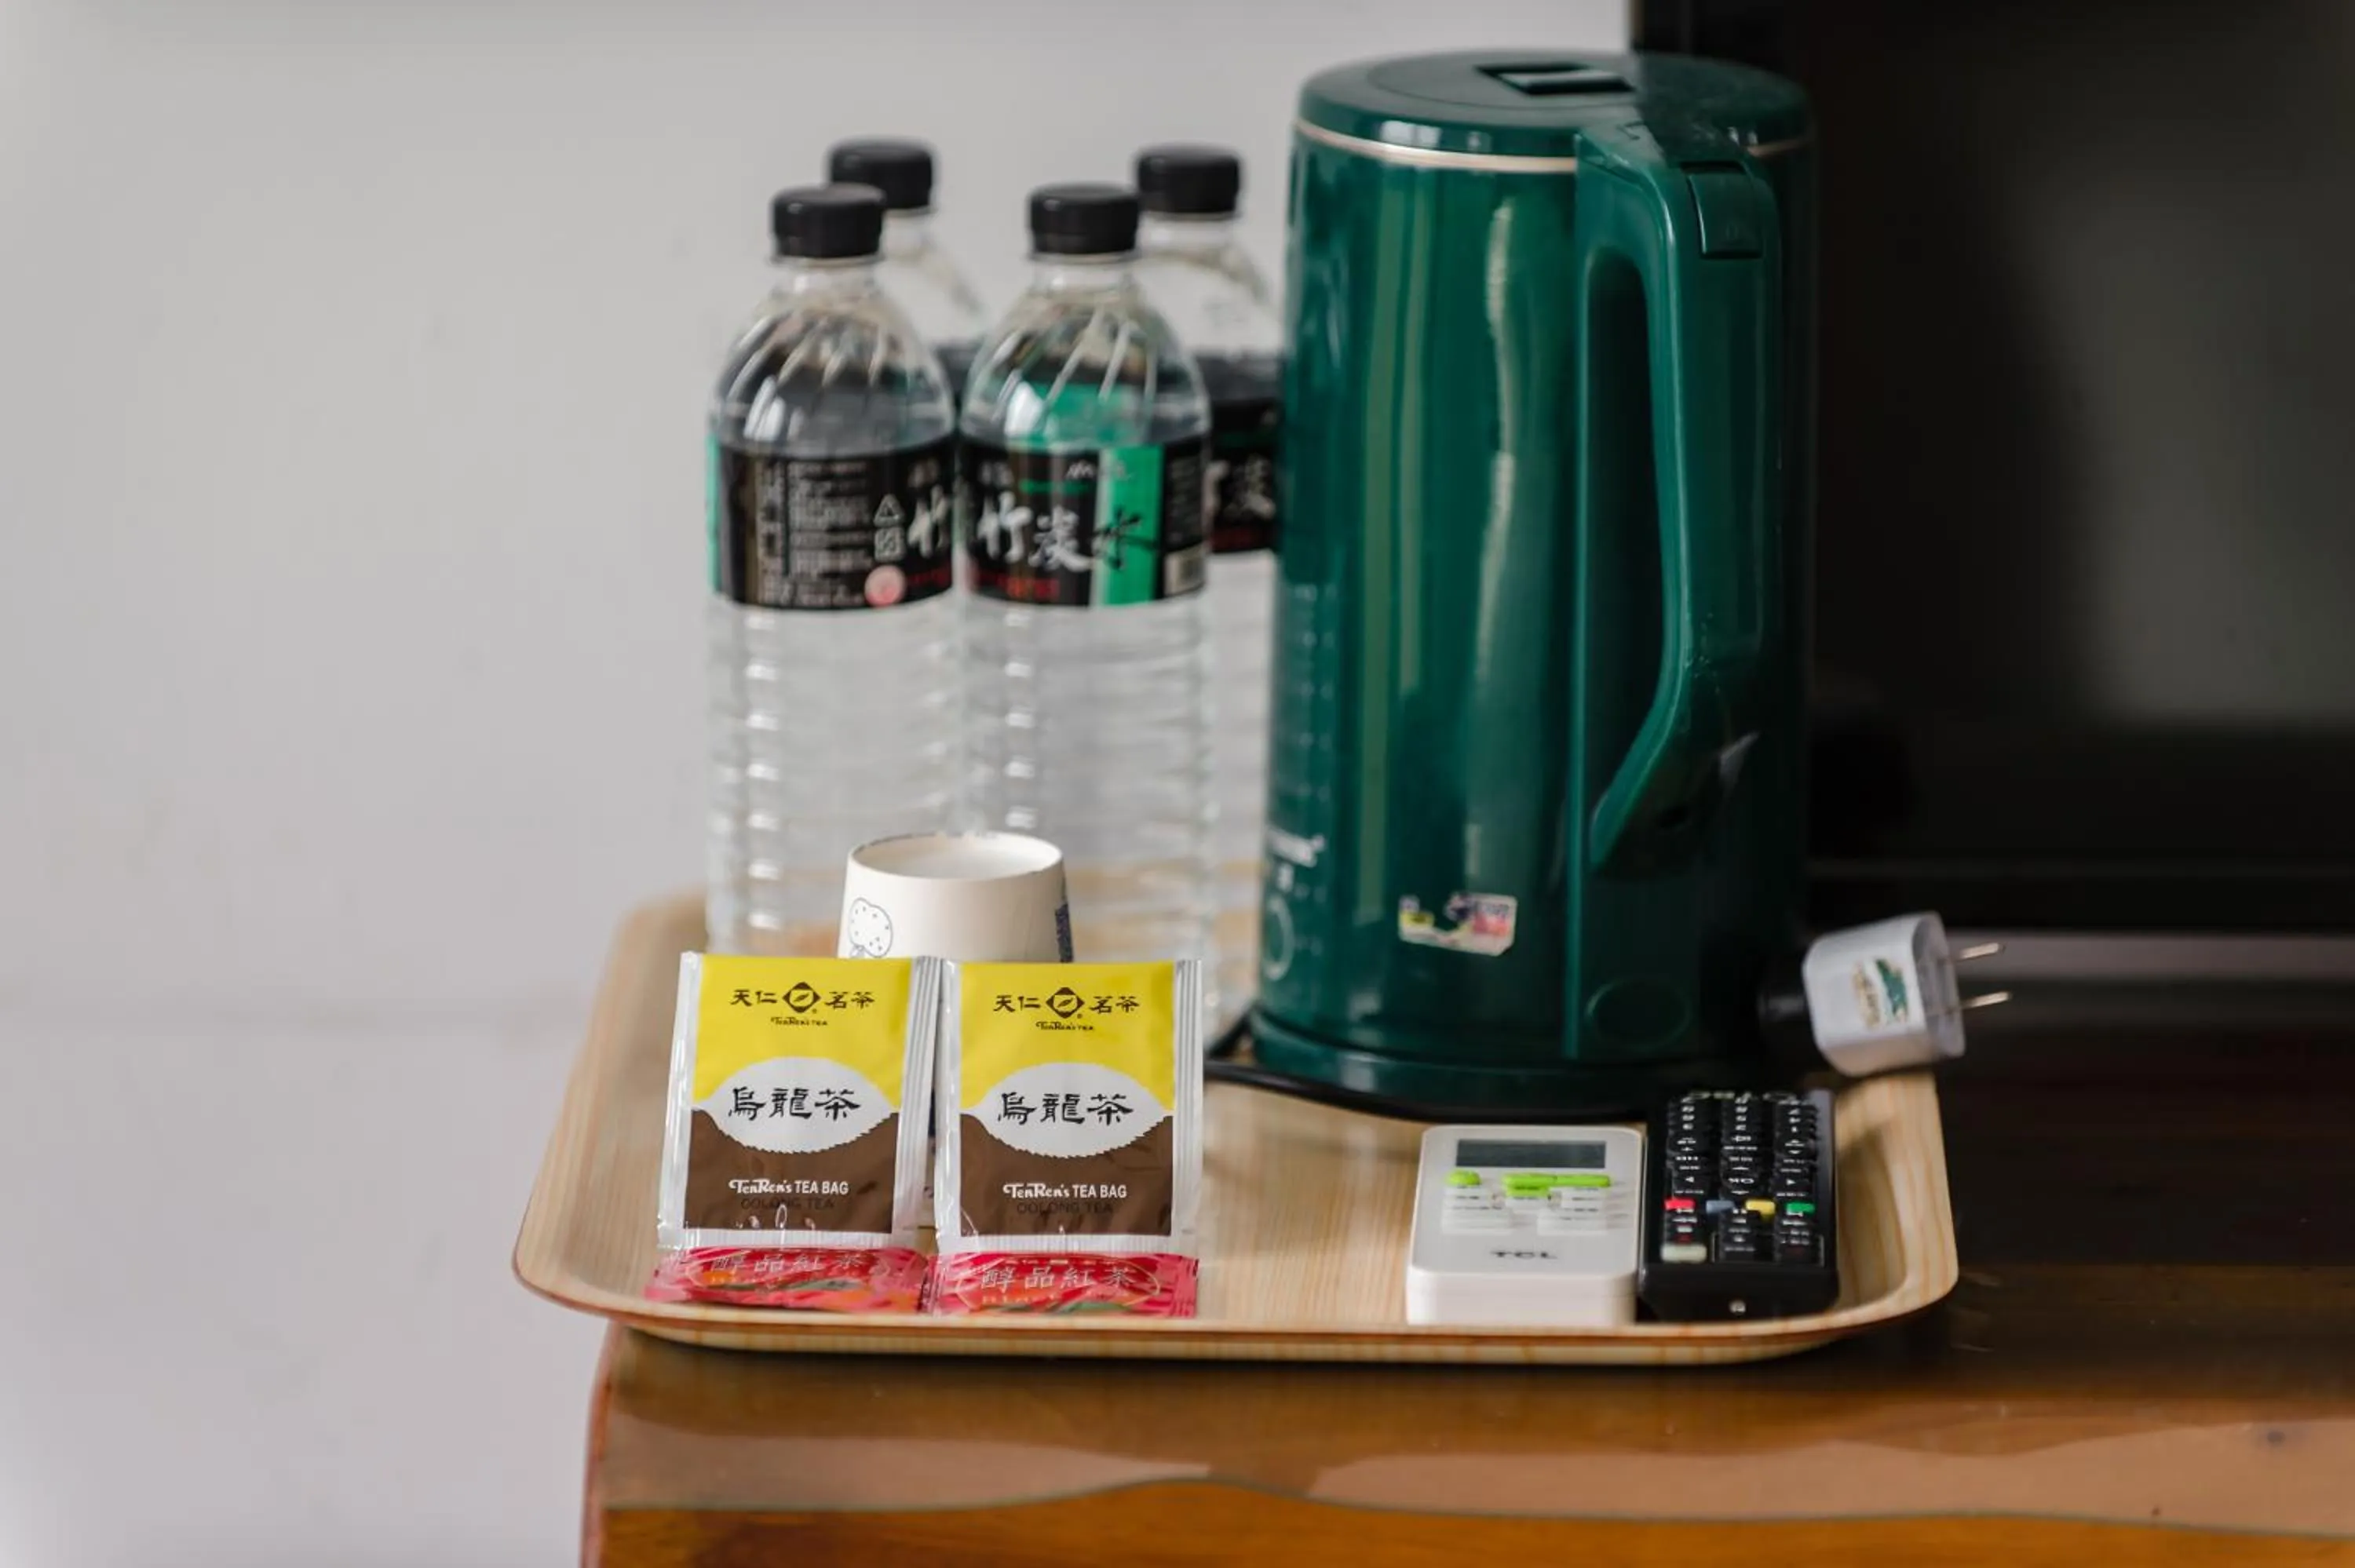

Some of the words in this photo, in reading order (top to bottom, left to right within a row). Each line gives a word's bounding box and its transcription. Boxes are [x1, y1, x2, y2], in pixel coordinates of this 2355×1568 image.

[730, 988, 778, 1008] 天仁
[824, 990, 875, 1010] 茗茶
[992, 994, 1042, 1013] 天仁
[1089, 994, 1141, 1015] 茗茶
[728, 1086, 861, 1121] 烏龍茶
[997, 1091, 1134, 1126] 烏龍茶
[794, 1180, 818, 1194] TEA
[822, 1180, 849, 1194] BAG
[1072, 1184, 1097, 1198] TEA
[1100, 1184, 1127, 1198] BAG
[740, 1196, 804, 1209] OOLONG
[807, 1195, 834, 1209] TEA
[1016, 1201, 1079, 1214] OOLONG
[1083, 1201, 1114, 1213] TEA
